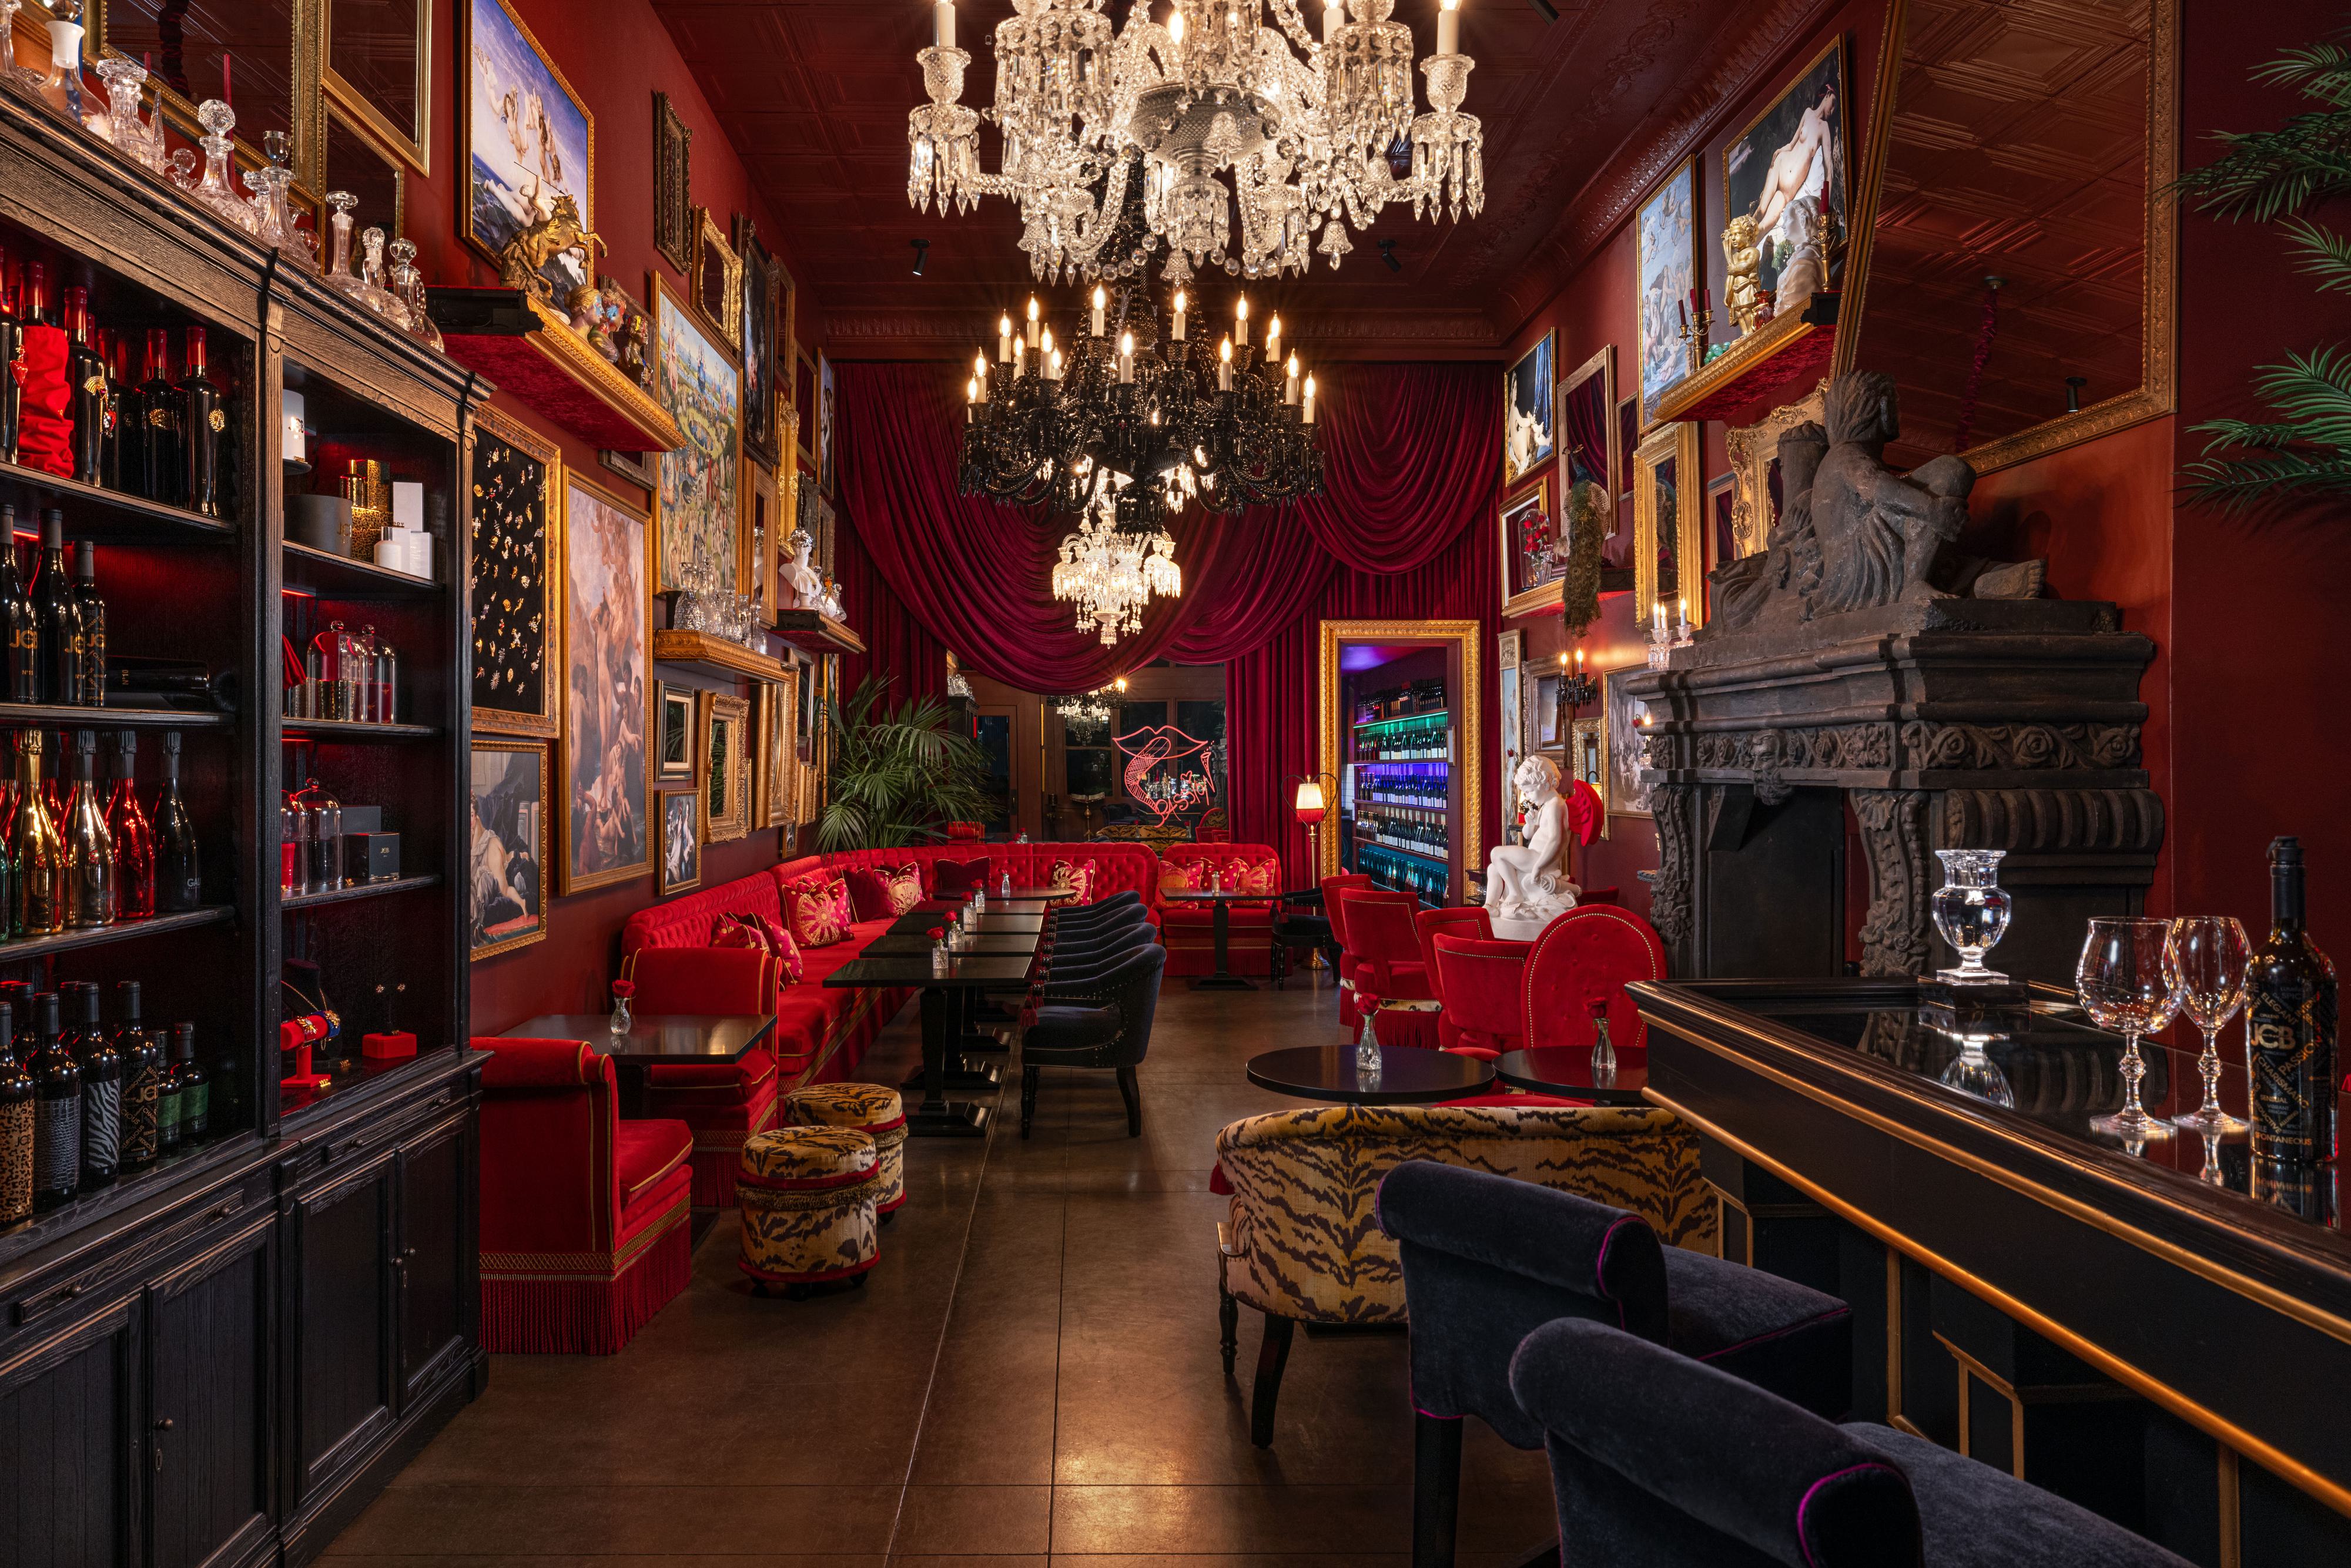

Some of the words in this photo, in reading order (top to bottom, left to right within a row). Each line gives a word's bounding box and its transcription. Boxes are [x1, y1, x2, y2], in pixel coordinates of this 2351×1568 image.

[2260, 991, 2299, 1026] ELEGANT
[2250, 1023, 2296, 1050] JCB
[15, 1134, 31, 1148] JCB
[2255, 1132, 2312, 1145] SPONTANEOUS
